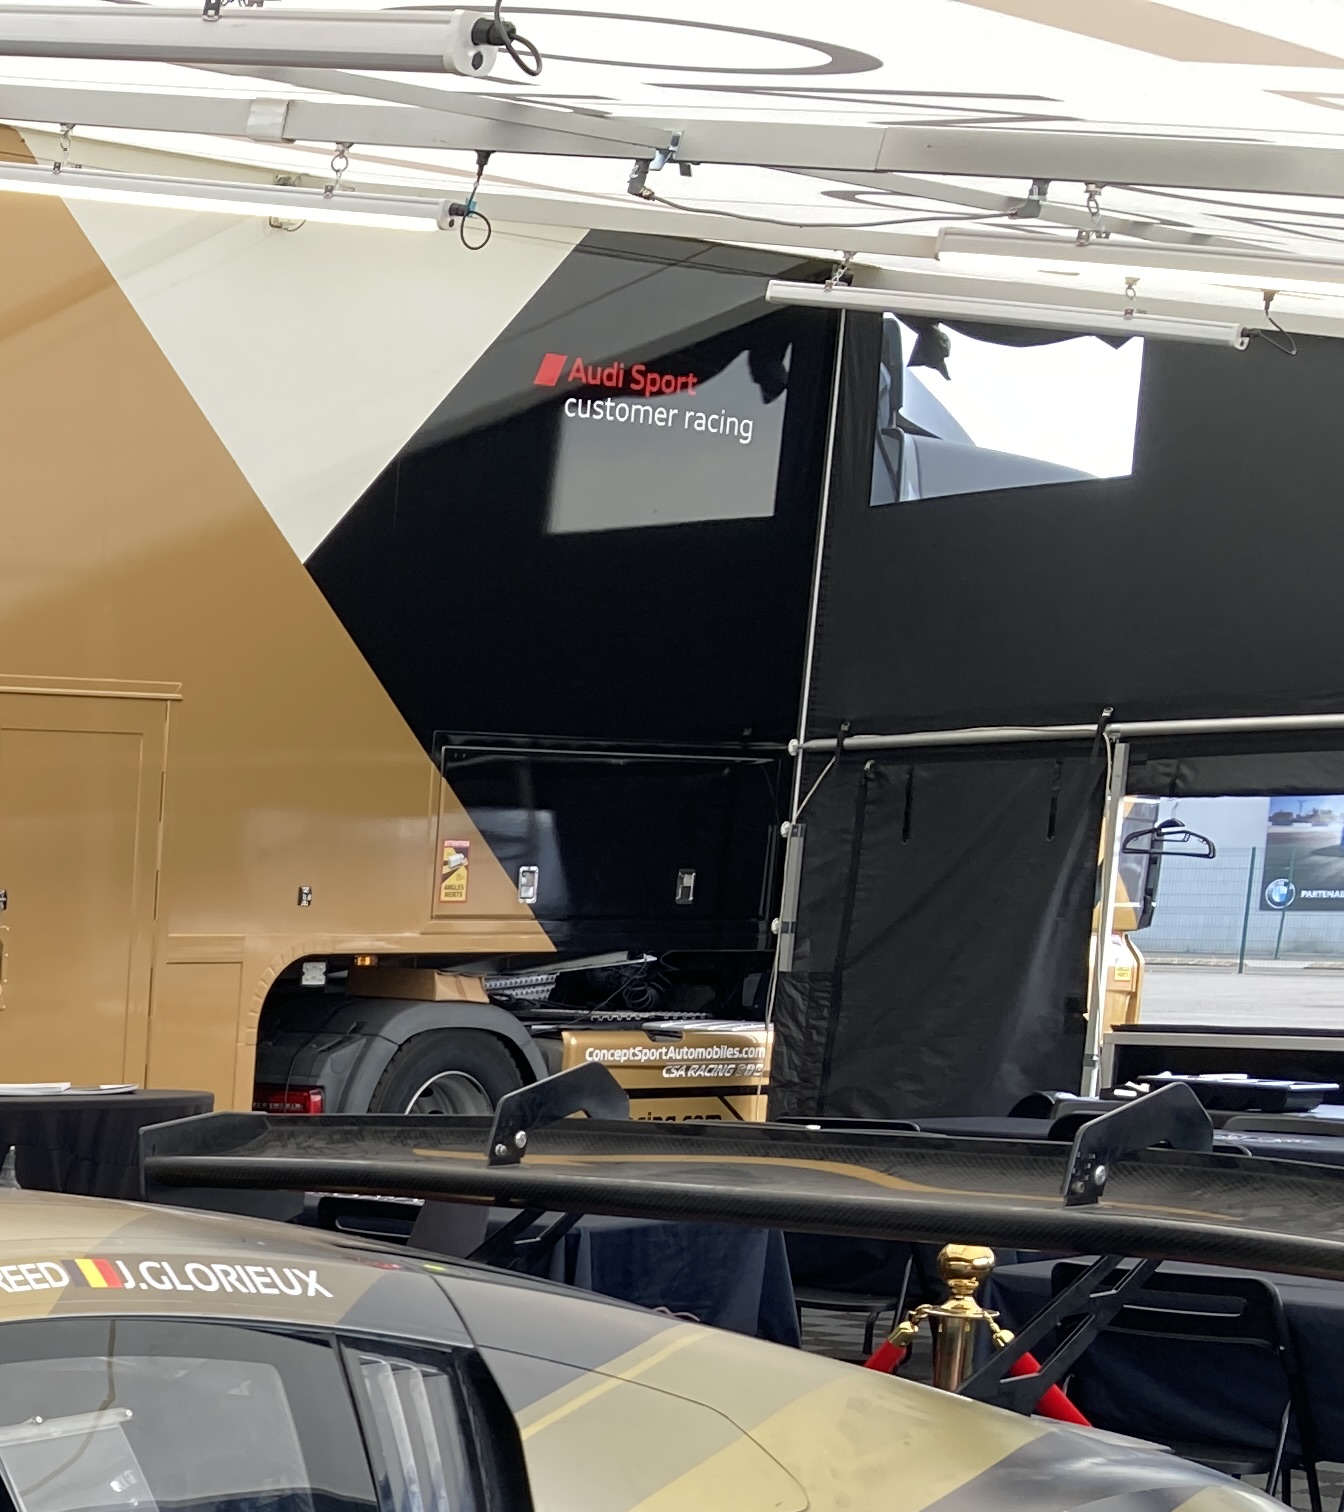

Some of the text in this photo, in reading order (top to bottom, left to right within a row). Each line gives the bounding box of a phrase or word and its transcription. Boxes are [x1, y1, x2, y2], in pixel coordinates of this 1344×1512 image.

[567, 357, 698, 398] Audi Sport
[563, 394, 754, 444] customer racing
[585, 1045, 766, 1063] ConceptSportAutomobiles.com
[662, 1064, 736, 1078] CSA RACING
[119, 1258, 333, 1299] J.GLORIEUX
